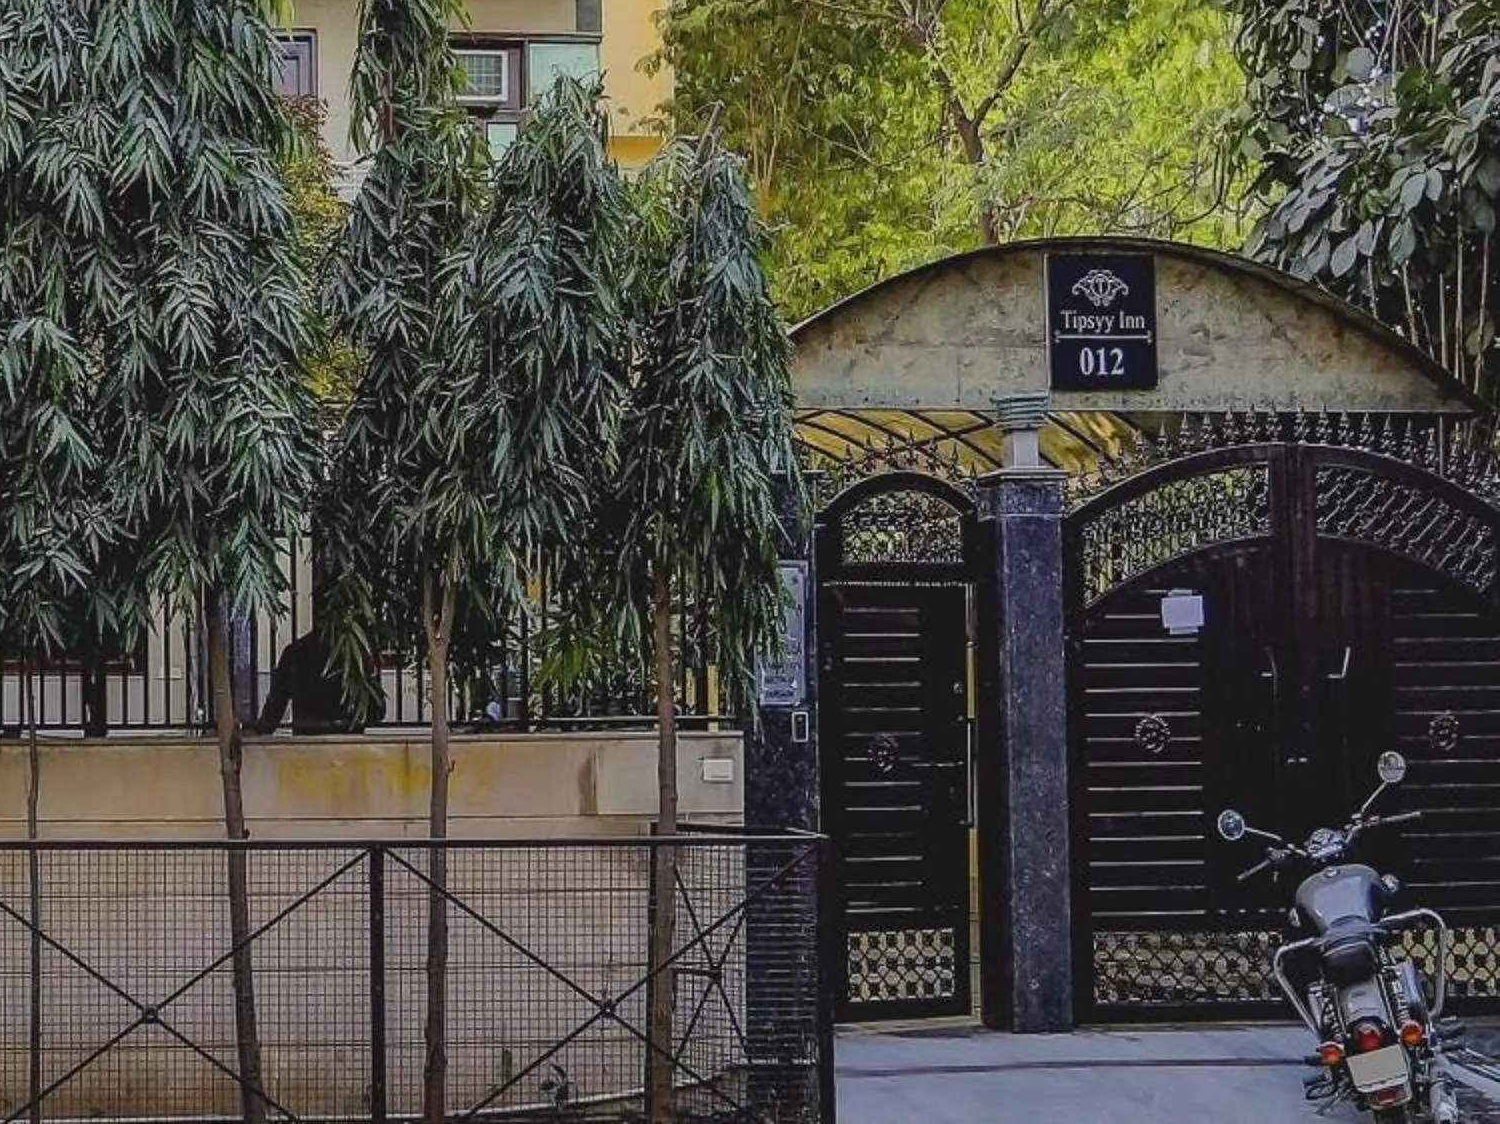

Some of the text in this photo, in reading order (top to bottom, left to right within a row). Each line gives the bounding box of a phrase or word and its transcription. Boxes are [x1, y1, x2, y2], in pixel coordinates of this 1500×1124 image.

[1060, 309, 1145, 333] Tipsyy Inn
[1079, 347, 1125, 376] 012
